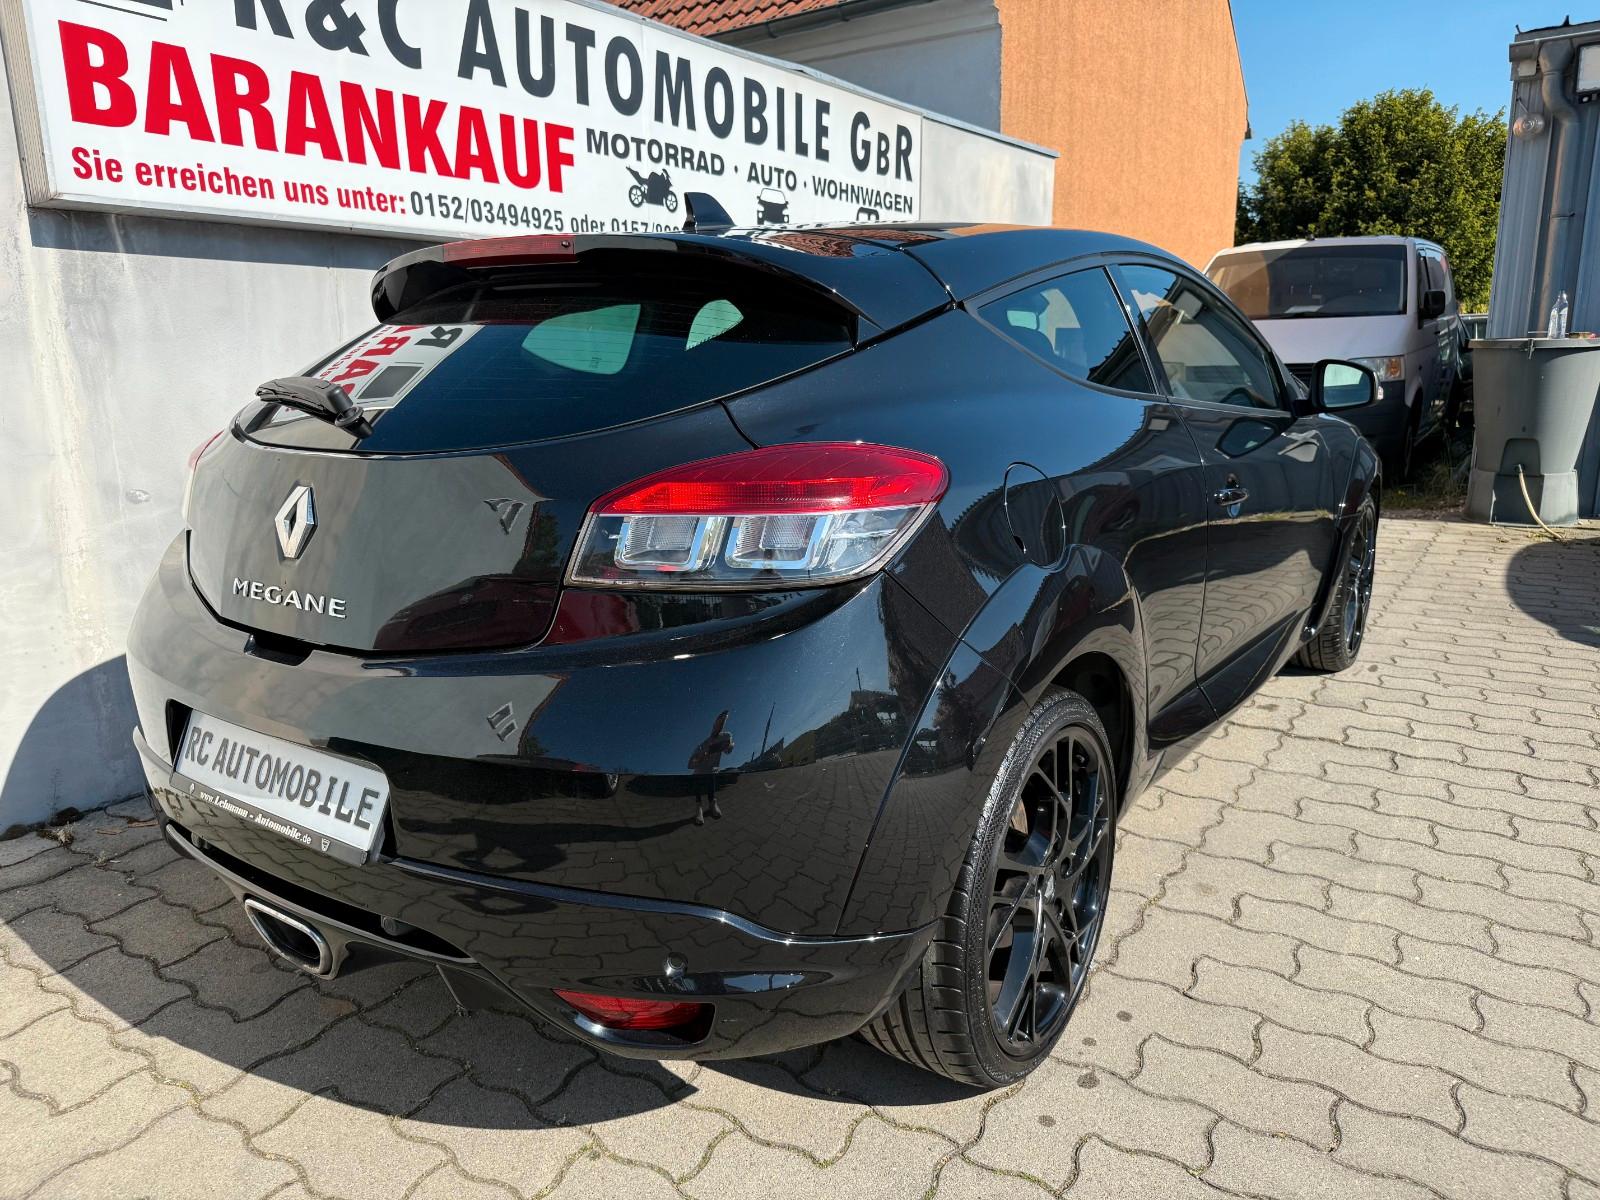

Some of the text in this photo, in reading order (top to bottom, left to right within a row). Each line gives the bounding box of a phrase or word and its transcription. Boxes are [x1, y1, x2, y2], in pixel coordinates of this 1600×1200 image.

[58, 20, 575, 193] BARANKAUF
[458, 0, 830, 162] AUTOMOBILE
[71, 146, 124, 183] Sie
[135, 162, 275, 200] erreichen
[283, 181, 329, 206] uns
[336, 186, 406, 214] unter:
[410, 190, 564, 232] 0152/03494925
[570, 214, 605, 233] oder
[586, 127, 913, 214] MOTORRAD AUTO WOHNWAGEN
[232, 577, 347, 619] MEGANE
[184, 725, 381, 831] RC AUTOMOBILE
[200, 790, 249, 818] www.Lehmann
[254, 813, 312, 845] Automobile.de
